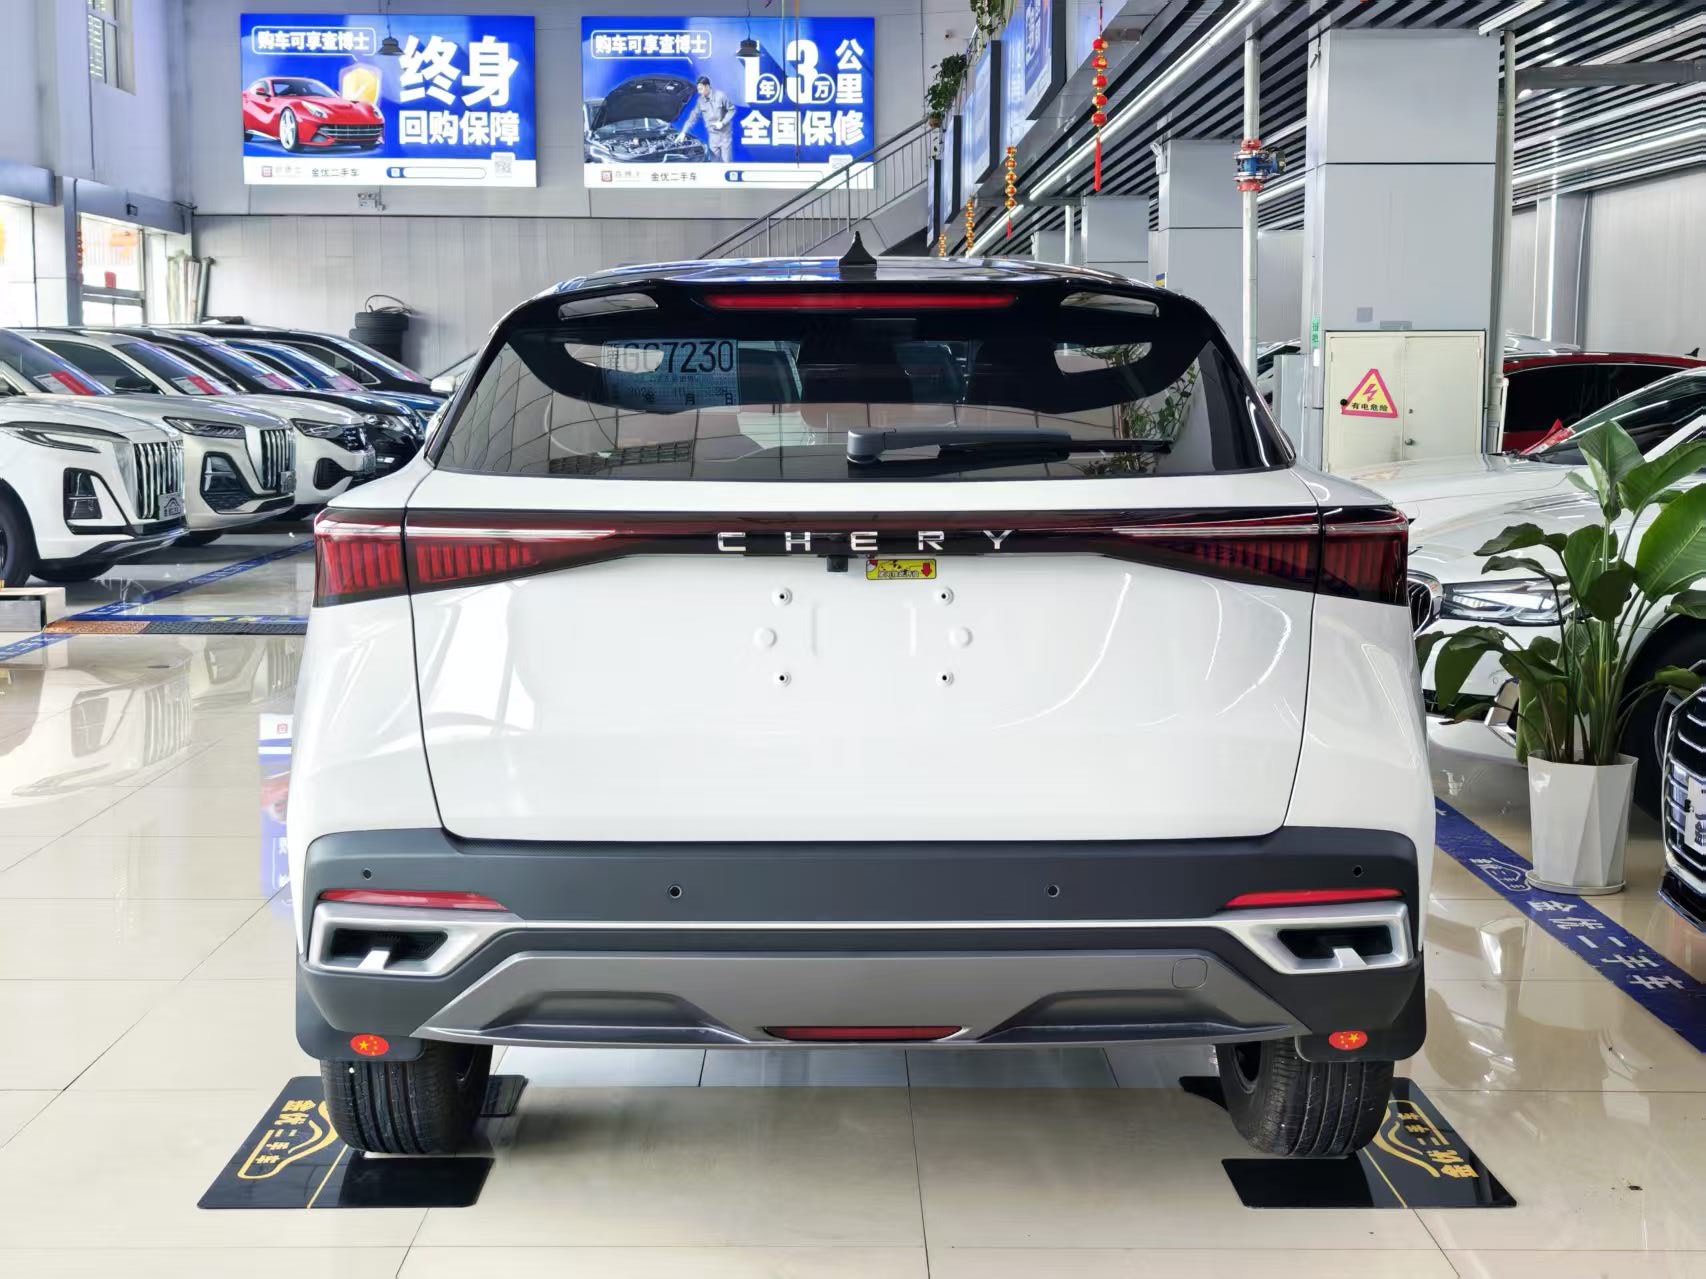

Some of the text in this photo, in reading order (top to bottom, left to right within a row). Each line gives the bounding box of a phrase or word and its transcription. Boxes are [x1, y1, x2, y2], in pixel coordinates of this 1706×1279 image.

[257, 31, 370, 51] 购车可享查博士
[595, 35, 707, 54] 购车可享查博士
[398, 35, 519, 107] 终身
[398, 110, 521, 146] 回购保障
[740, 110, 865, 146] 全国保修
[1351, 402, 1389, 412] 有电危险
[717, 530, 1014, 552] CHERY
